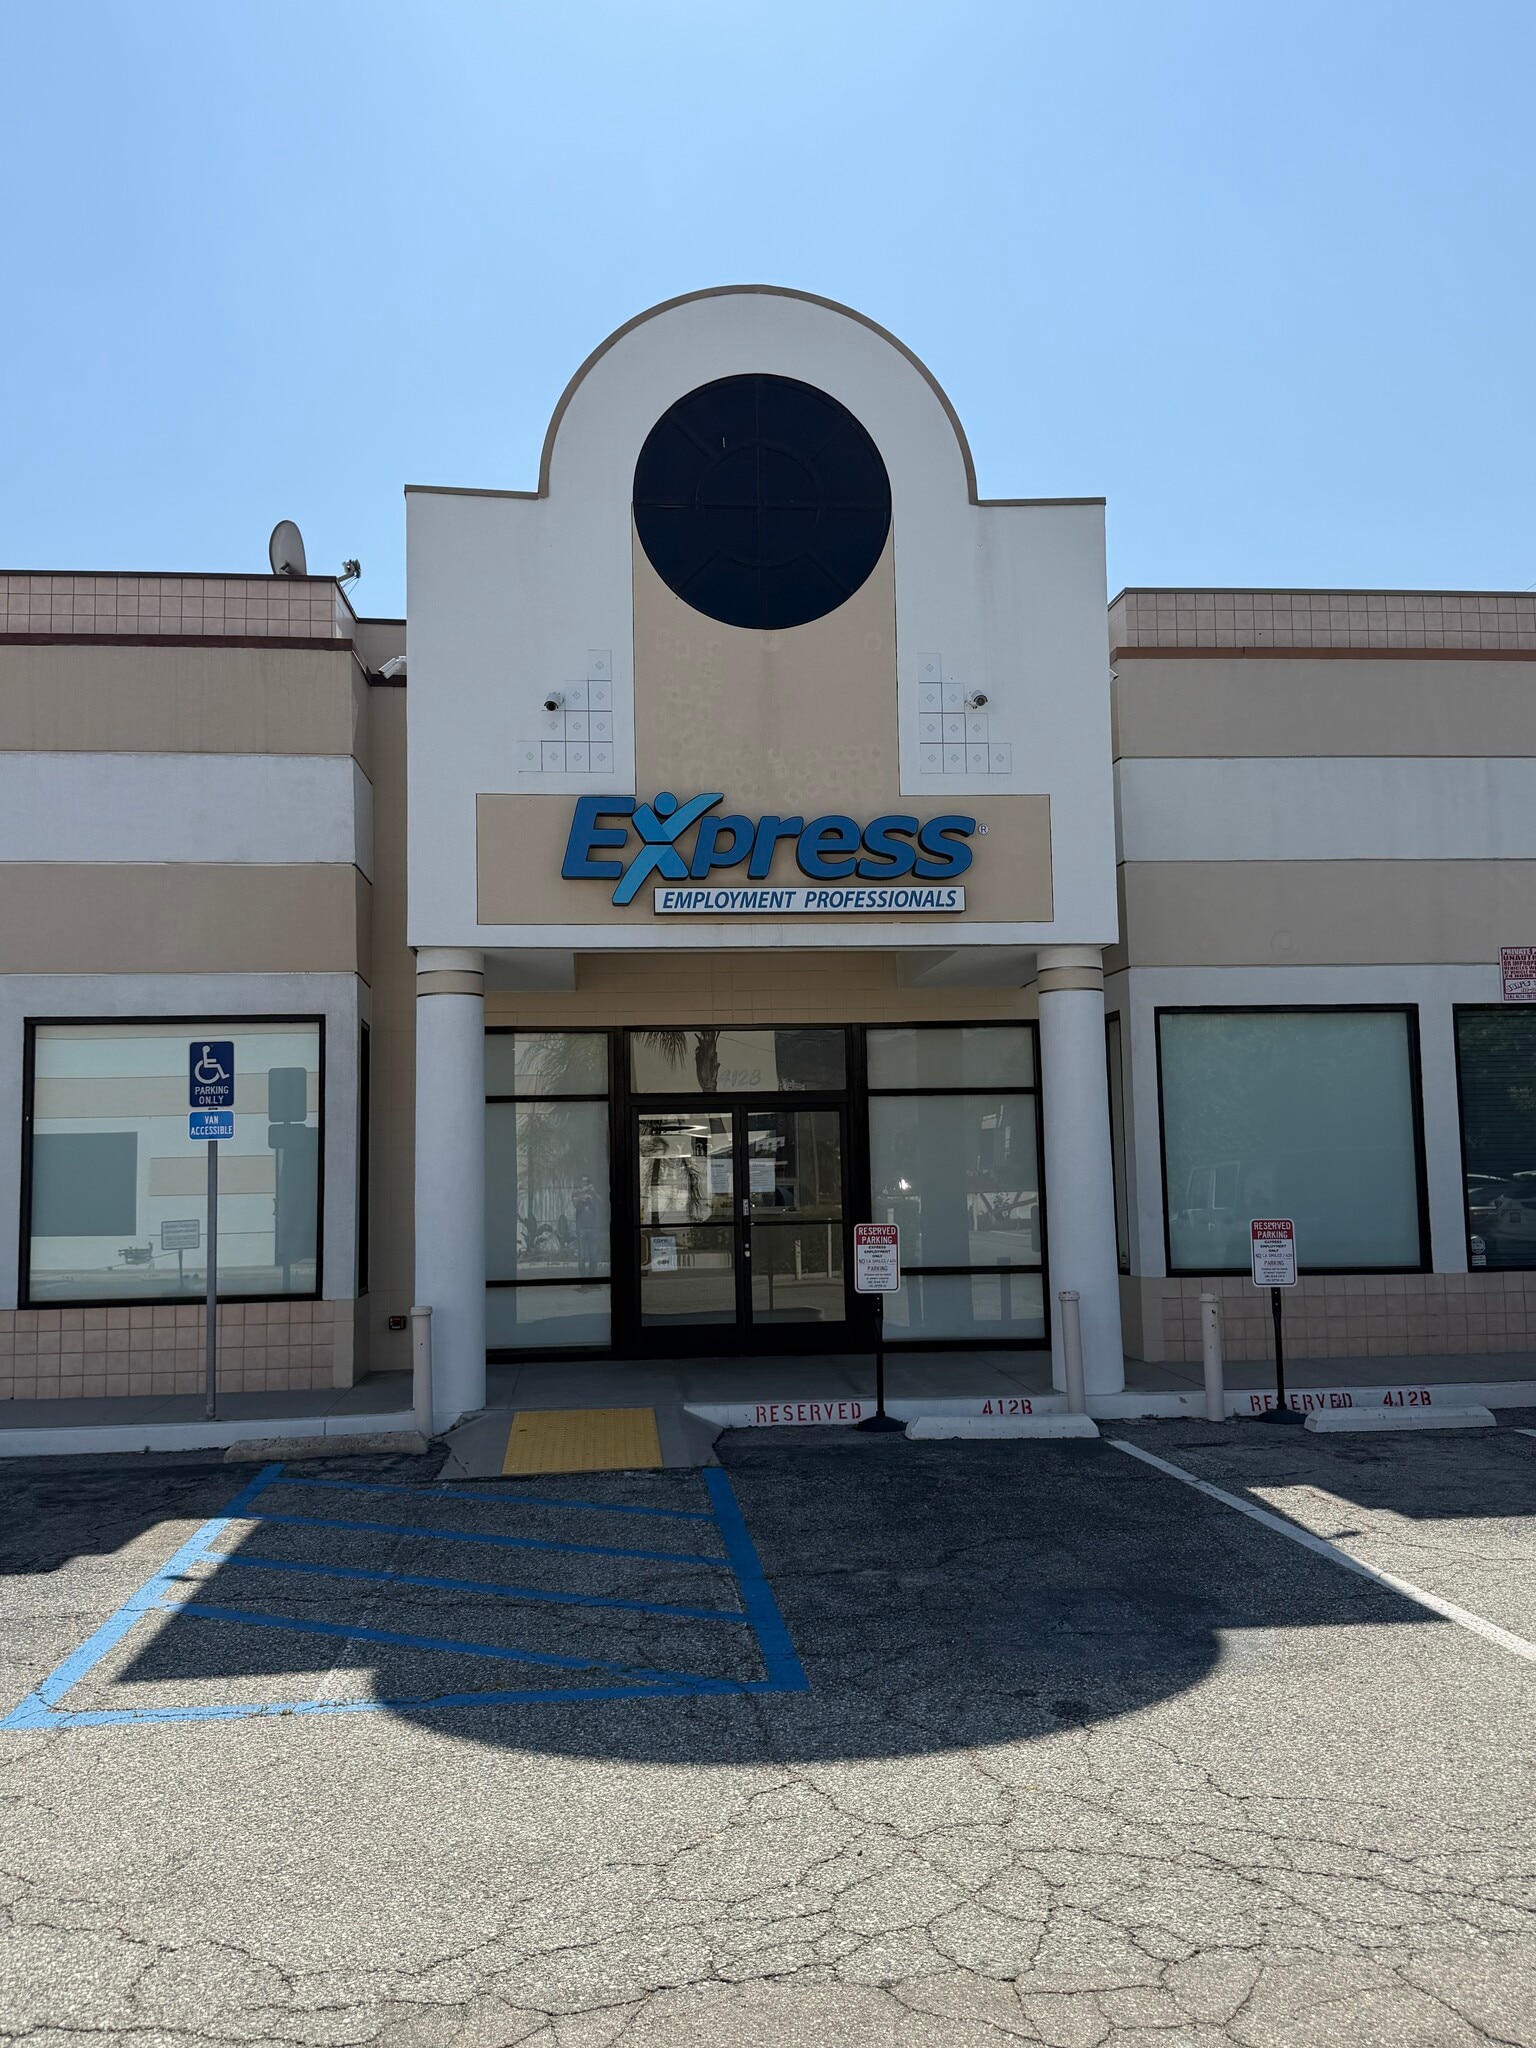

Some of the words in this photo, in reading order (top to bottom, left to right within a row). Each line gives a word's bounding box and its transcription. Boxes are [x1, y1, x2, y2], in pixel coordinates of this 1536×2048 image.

[662, 890, 796, 909] EMPLOYMENT
[804, 889, 957, 909] PROFESSIONALS
[195, 1086, 229, 1095] PARKING
[199, 1096, 224, 1104] ONLY
[204, 1115, 219, 1124] VAN
[190, 1126, 233, 1135] ACCESSIBLE
[1253, 1221, 1291, 1230] RESERVED
[858, 1227, 896, 1235] RESERVED
[1257, 1230, 1288, 1238] PARKING
[861, 1236, 893, 1244] PARKING
[1250, 1392, 1353, 1412] REERVED
[1383, 1390, 1432, 1406] 412B
[755, 1402, 862, 1424] RESERVED
[982, 1398, 1033, 1415] 412B
